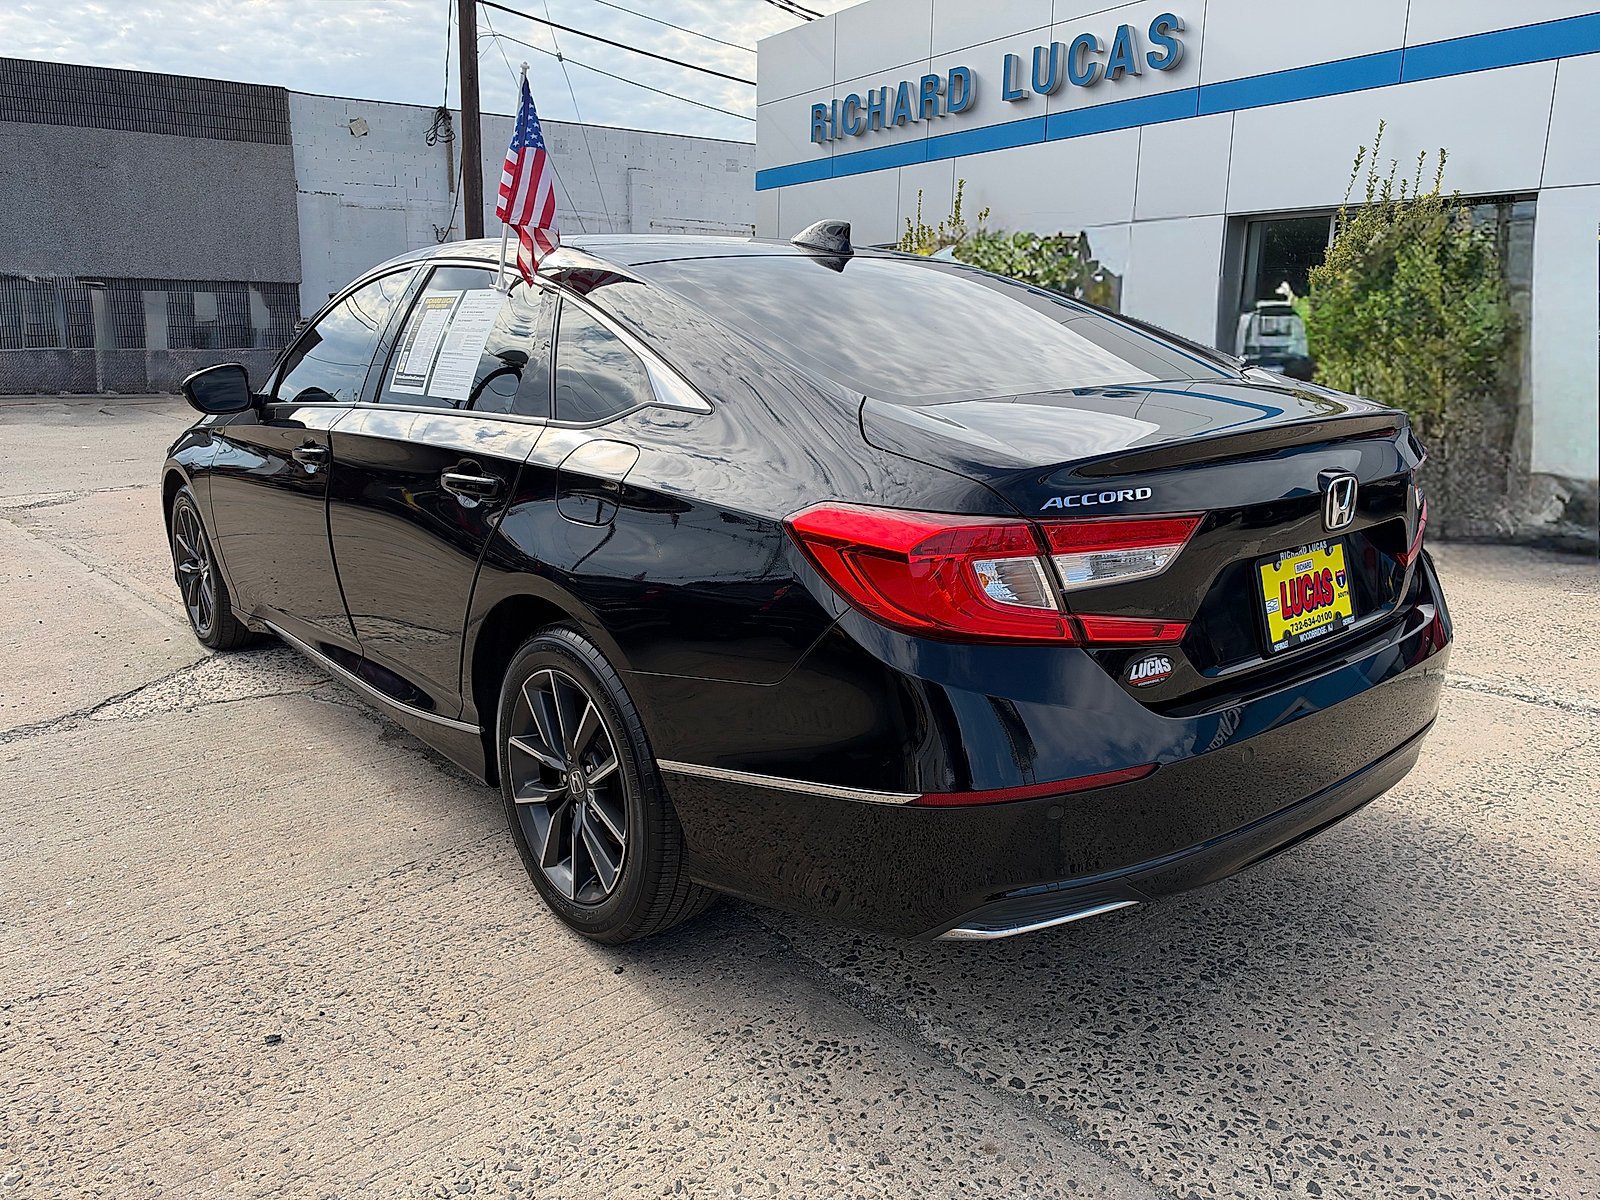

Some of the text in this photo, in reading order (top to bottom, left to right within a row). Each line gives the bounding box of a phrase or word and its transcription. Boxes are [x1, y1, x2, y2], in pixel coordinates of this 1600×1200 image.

[810, 12, 1186, 144] RICHARD LUCAS
[1039, 487, 1152, 511] ACCORD
[1308, 540, 1328, 553] LUCAS
[1280, 568, 1335, 620] LUCAS
[1290, 610, 1333, 633] 732-634-0100
[1130, 657, 1172, 681] LUCAS
